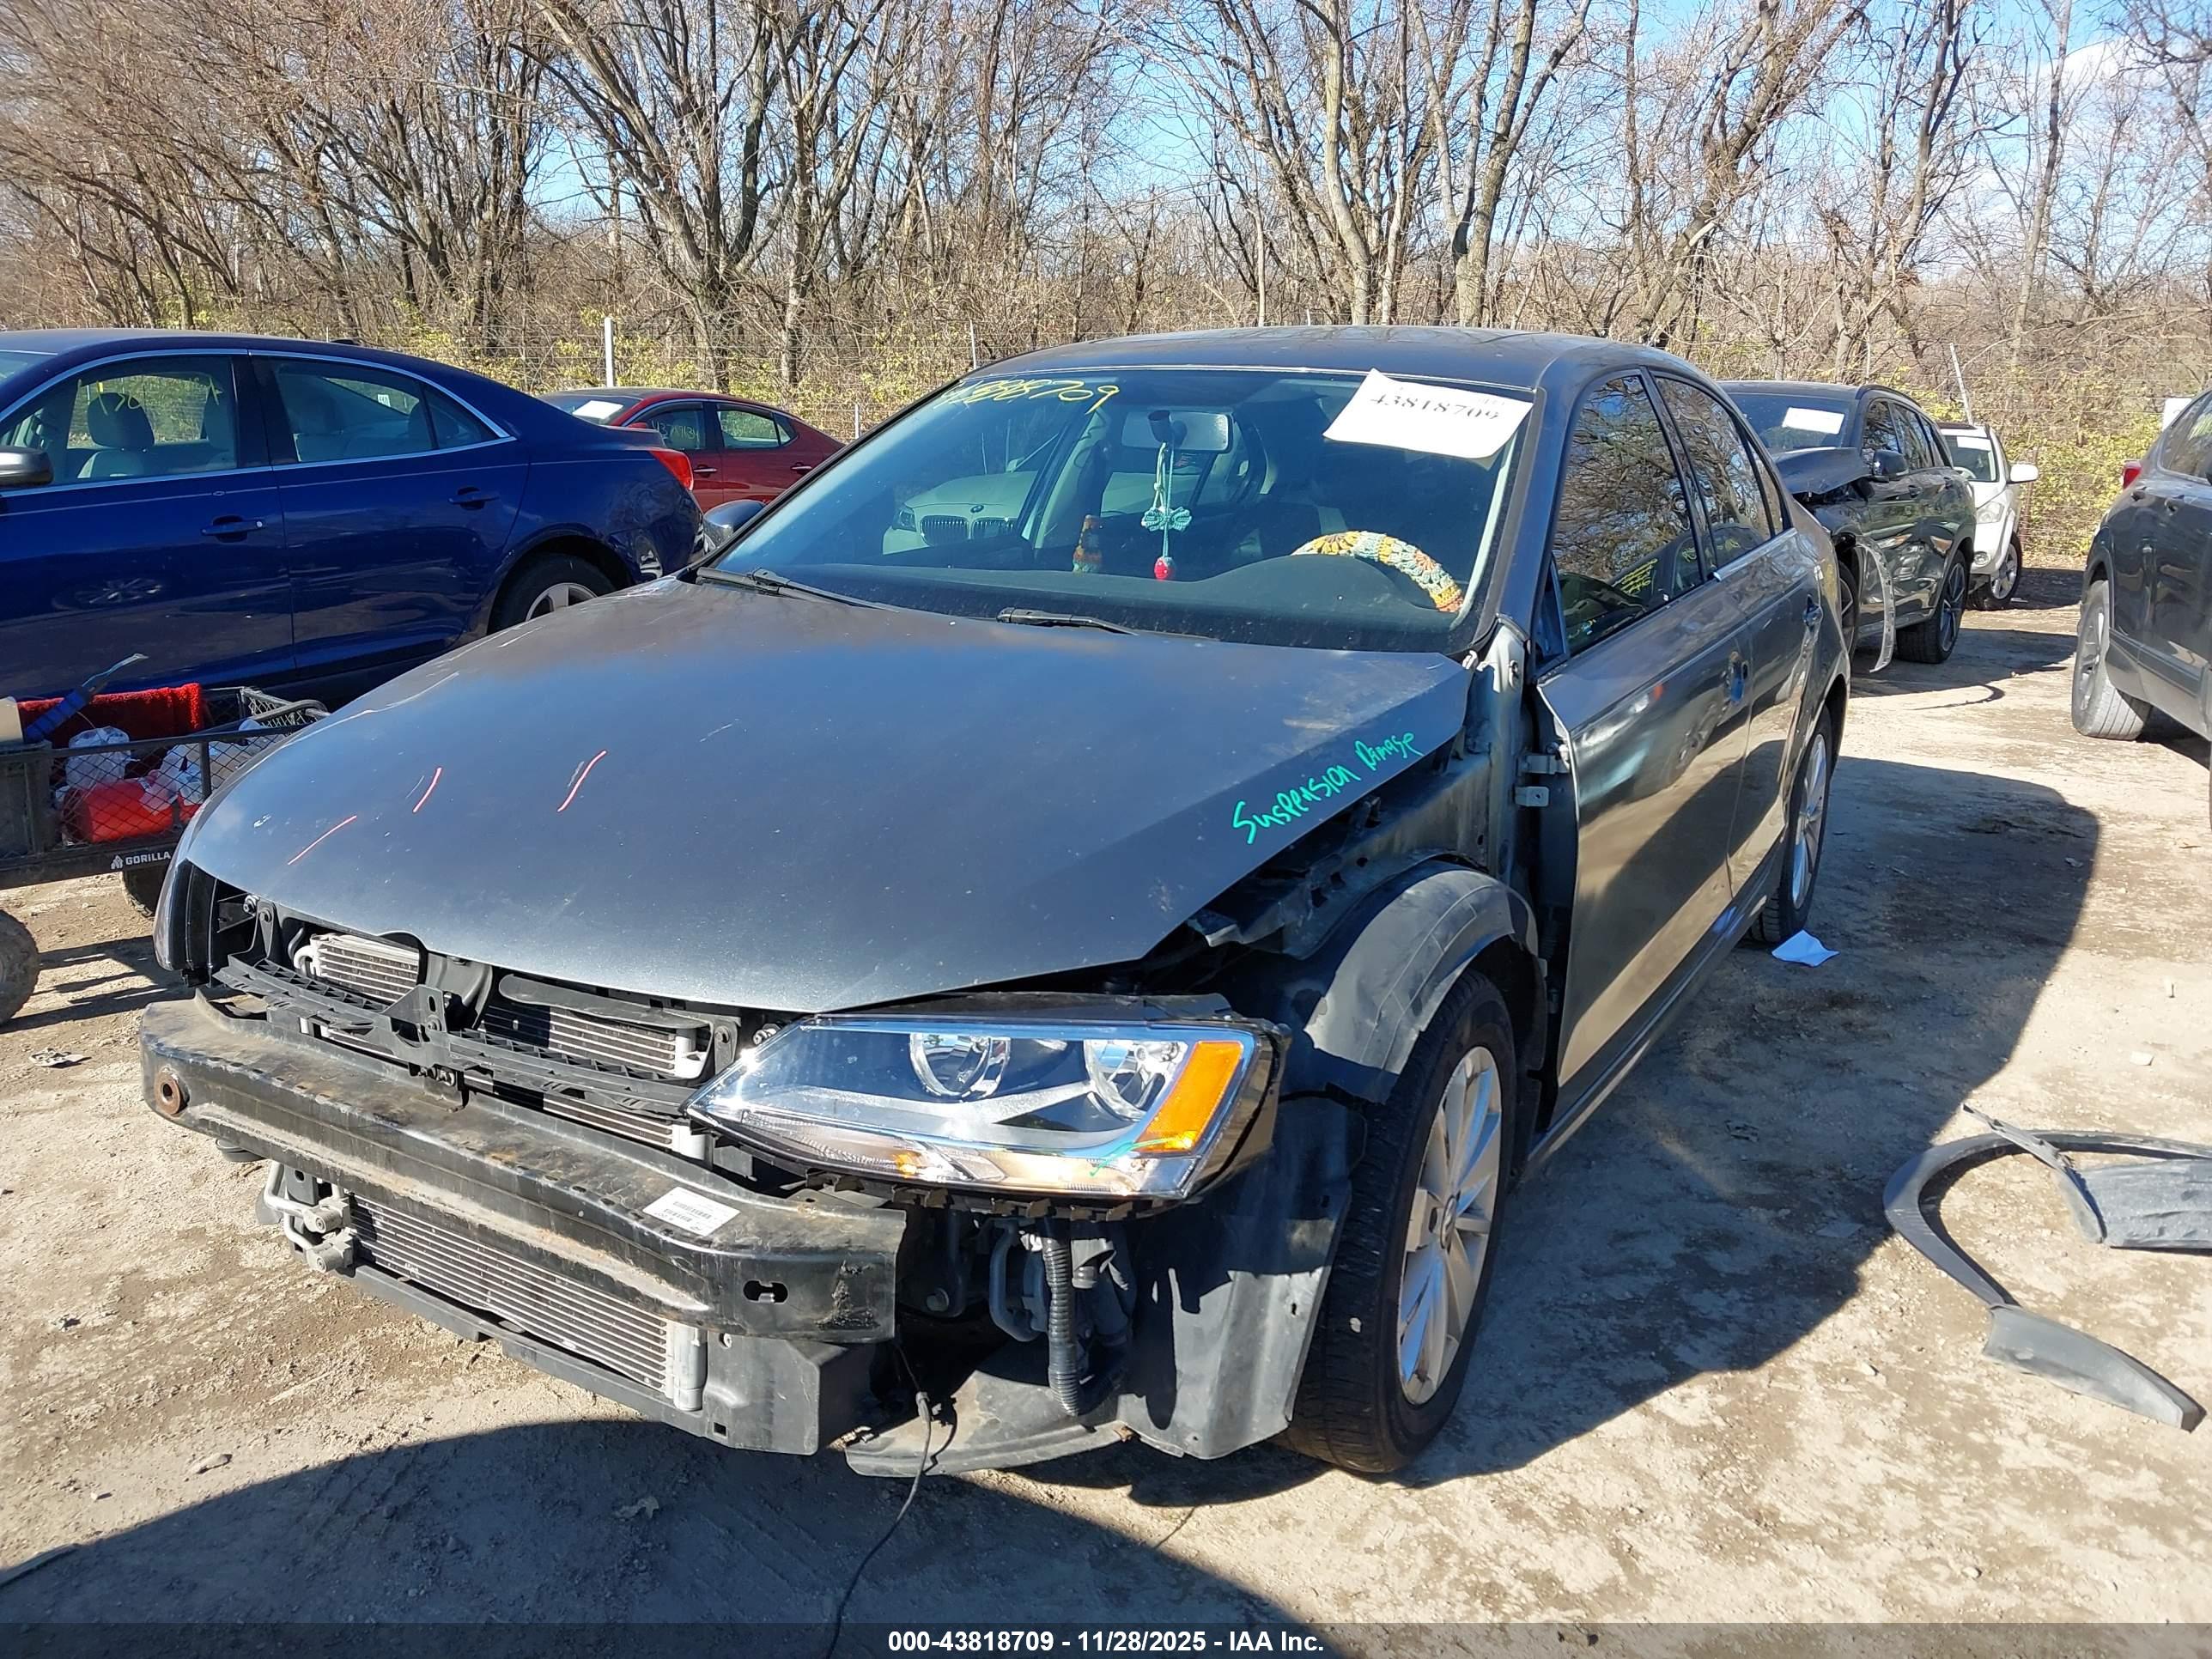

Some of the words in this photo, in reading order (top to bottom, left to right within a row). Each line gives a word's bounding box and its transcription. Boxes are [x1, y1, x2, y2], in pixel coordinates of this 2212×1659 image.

[1370, 394, 1500, 420] 43818709
[1231, 765, 1361, 845] Suspension
[125, 851, 171, 866] GORILLA
